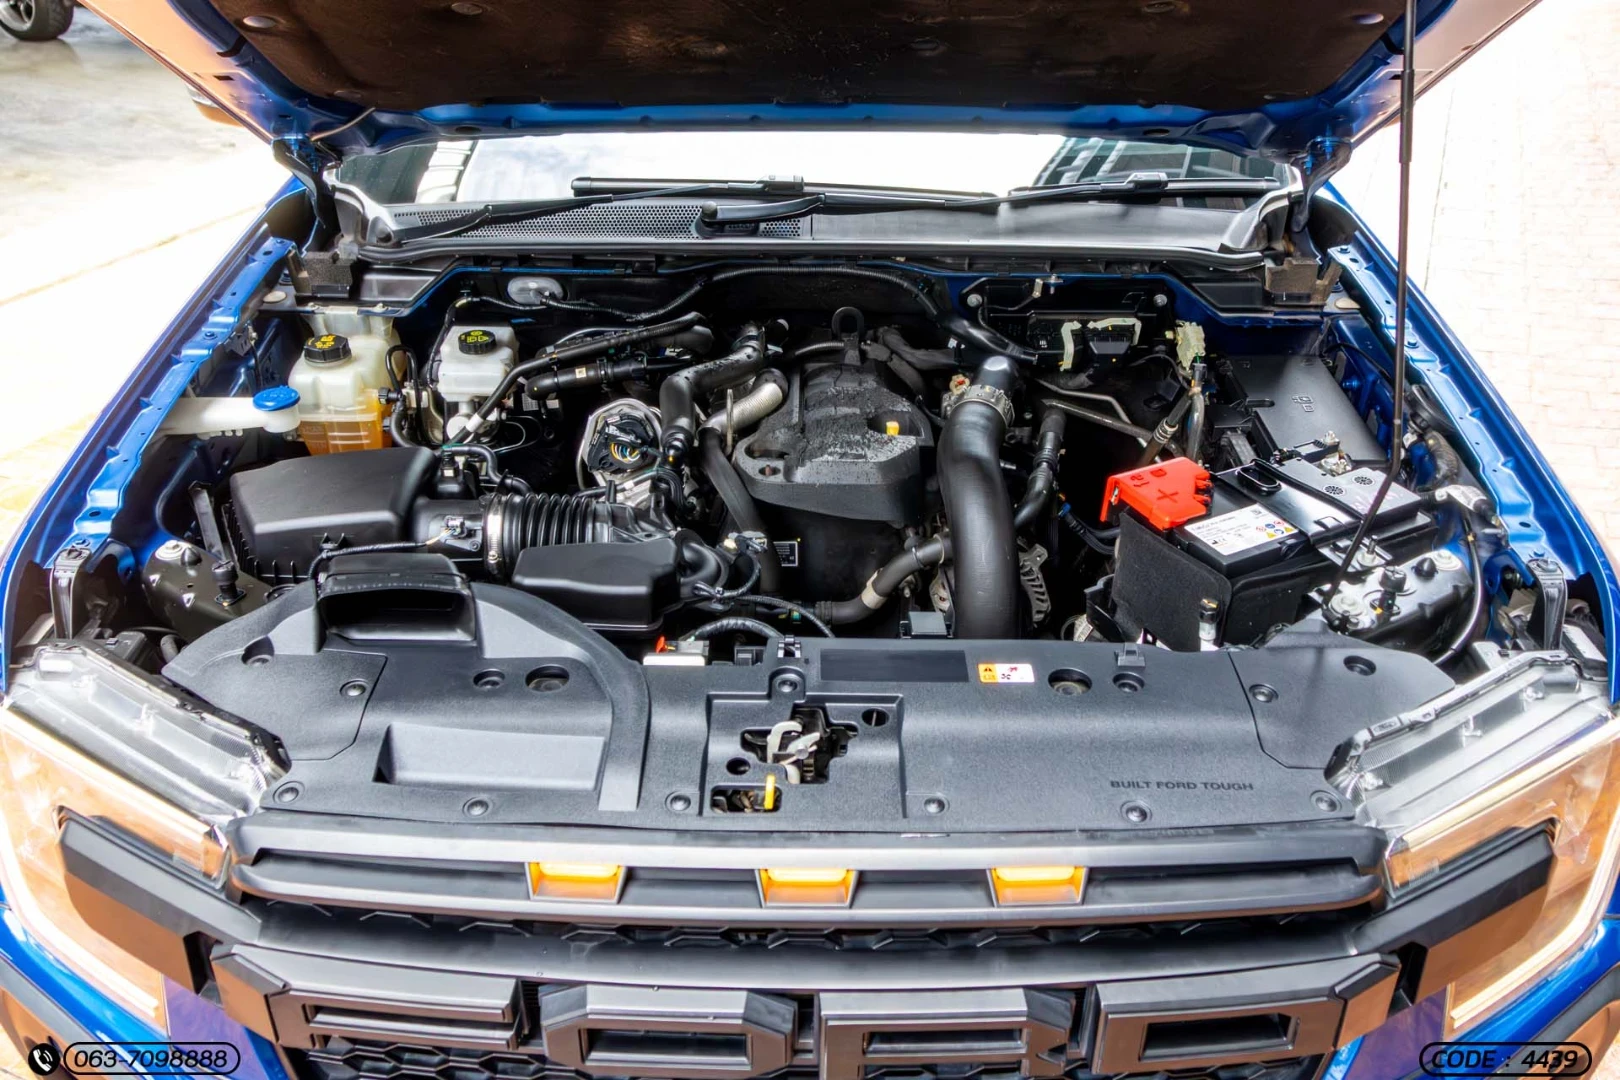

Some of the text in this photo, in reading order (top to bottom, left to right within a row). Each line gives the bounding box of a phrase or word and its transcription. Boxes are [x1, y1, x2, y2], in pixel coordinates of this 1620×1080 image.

[1110, 780, 1254, 791] BUILT FORD TOUGH
